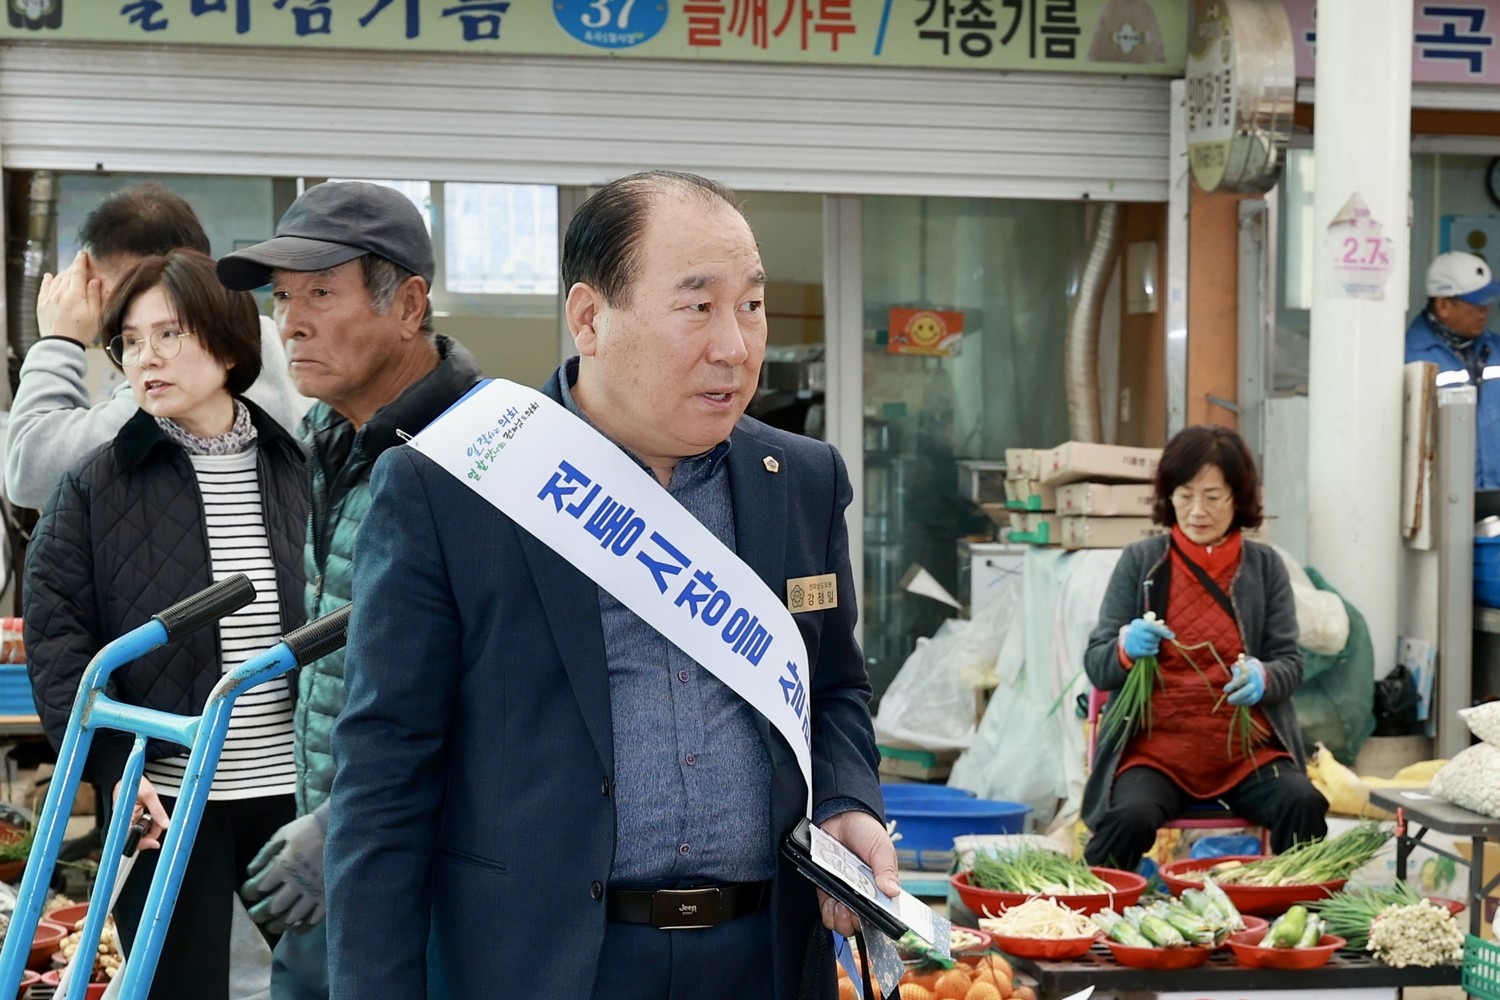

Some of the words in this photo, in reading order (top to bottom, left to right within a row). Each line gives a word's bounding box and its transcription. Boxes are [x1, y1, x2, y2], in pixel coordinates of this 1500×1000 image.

[581, 0, 636, 29] 37
[913, 0, 1080, 59] 각종기름
[537, 459, 774, 668] 전통시장을
[678, 903, 698, 913] Jeep
